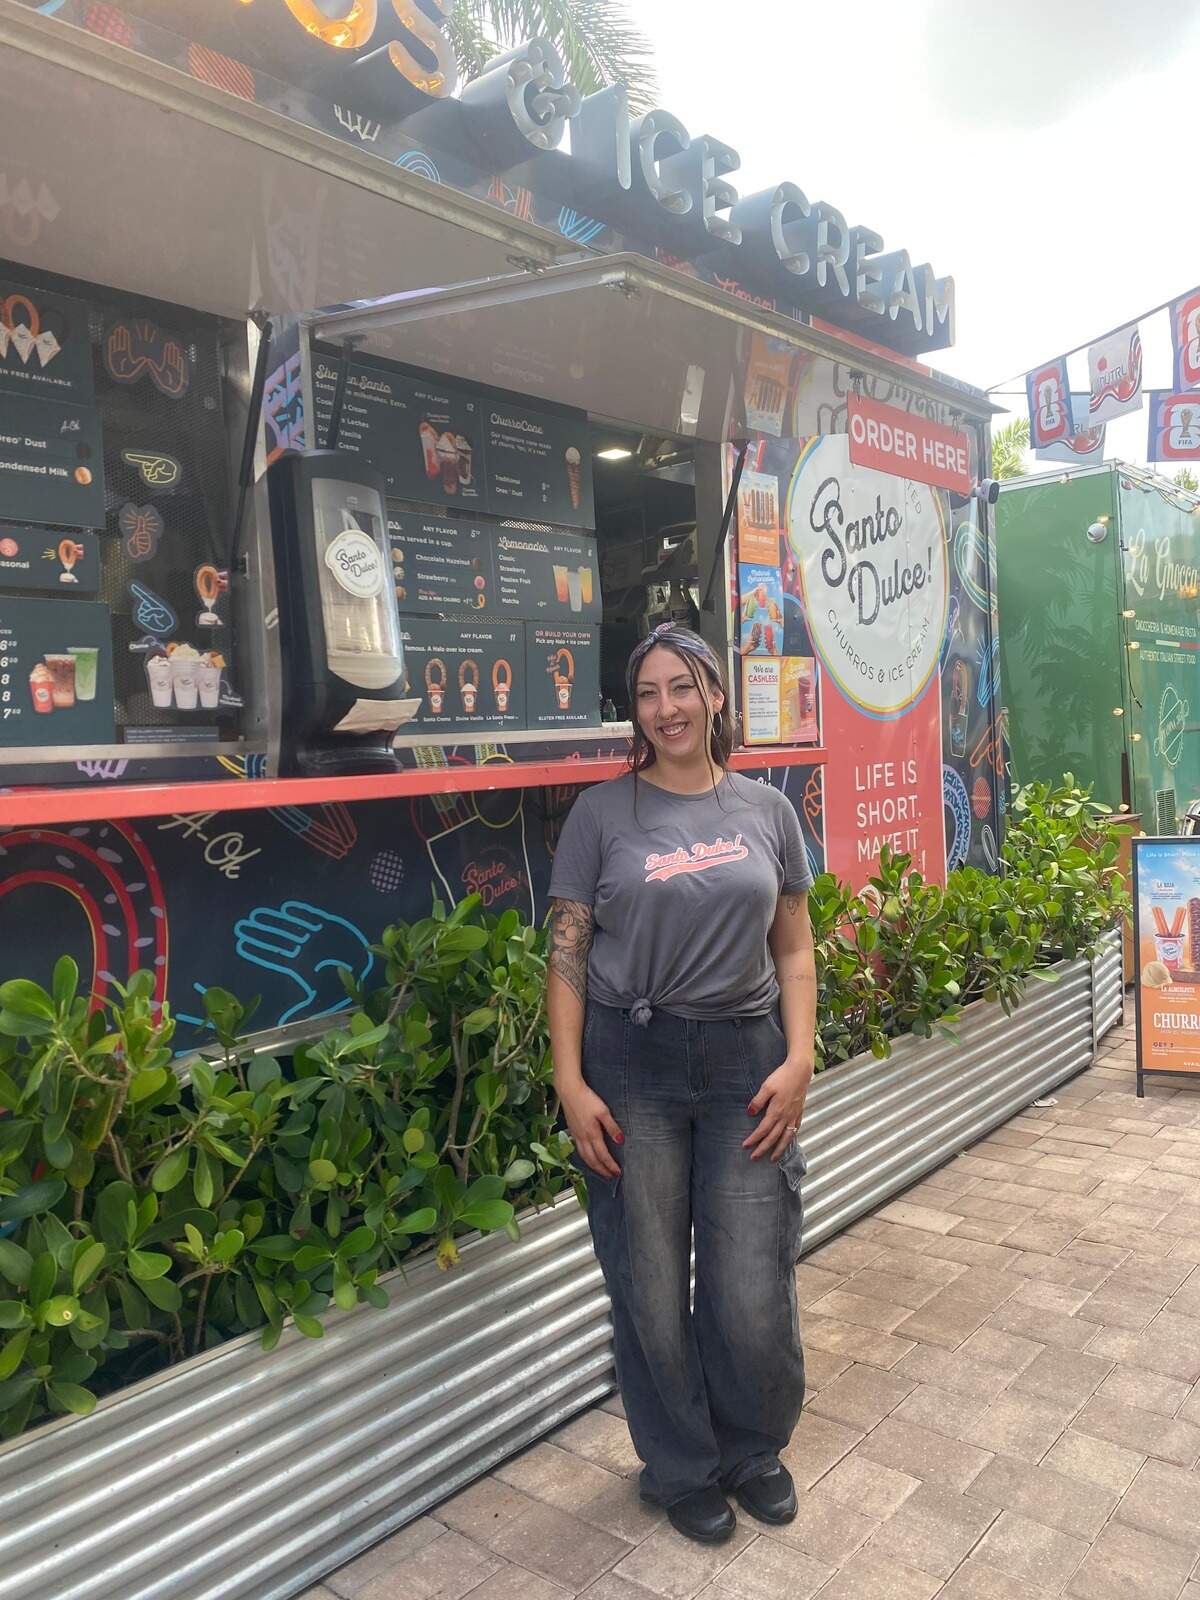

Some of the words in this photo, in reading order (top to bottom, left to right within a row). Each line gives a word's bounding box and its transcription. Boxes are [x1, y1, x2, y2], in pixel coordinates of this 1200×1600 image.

[614, 83, 743, 246] ICE
[769, 181, 956, 348] CREAM
[32, 374, 72, 387] AVAILABLE
[360, 375, 392, 394] Santo
[24, 437, 47, 449] Dust
[850, 414, 919, 462] ORDER
[922, 437, 968, 476] HERE
[1177, 438, 1193, 446] FIFA
[0, 461, 47, 474] ondensed
[48, 466, 69, 477] Milk
[406, 536, 428, 544] served
[435, 527, 458, 536] FLAVOR
[809, 476, 904, 588] Santo
[498, 536, 550, 553] Lemonades
[0, 559, 30, 569] asonal
[335, 548, 367, 571] Santo
[415, 553, 445, 563] Chocolate
[446, 557, 471, 566] Hazelnut
[1125, 527, 1150, 597] La
[417, 573, 449, 583] Strawberry
[847, 546, 934, 626] Dulce!
[827, 608, 875, 681] CHURROS
[877, 668, 886, 684] &
[888, 664, 904, 683] ICE
[905, 616, 931, 670] CREAM
[1, 673, 10, 685] 8
[748, 674, 778, 683] CASHLESS
[2, 690, 11, 702] 8
[855, 761, 895, 792] LIFE
[902, 759, 918, 785] IS
[856, 794, 923, 829] SHORT.
[906, 828, 919, 852] IT
[644, 847, 690, 871] Santo
[691, 833, 743, 862] Dulce!
[461, 860, 507, 896] Santo
[1153, 1012, 1200, 1030] CHURR
